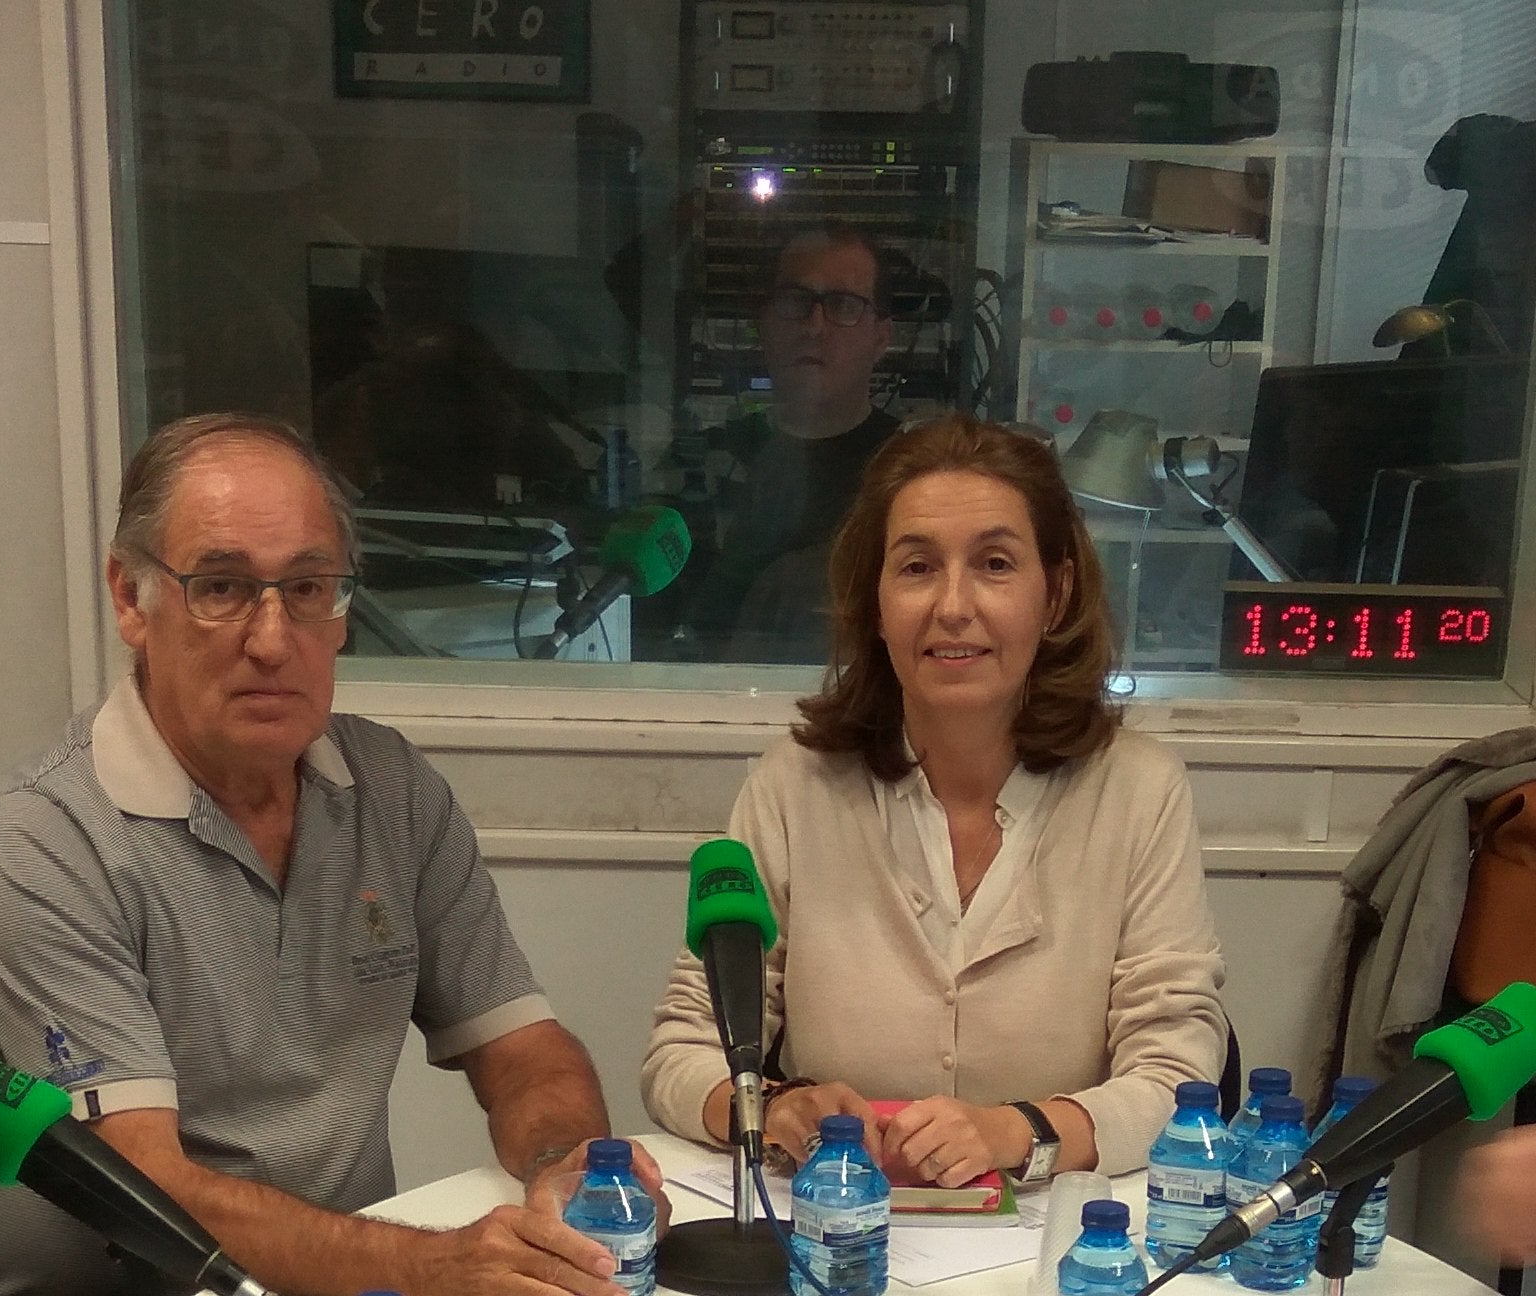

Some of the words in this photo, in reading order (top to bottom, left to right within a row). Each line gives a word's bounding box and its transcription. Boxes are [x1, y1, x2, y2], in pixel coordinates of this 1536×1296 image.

[364, 0, 543, 38] CERO
[367, 59, 547, 77] RADIO
[1244, 605, 1415, 658] 13:11
[1438, 608, 1490, 642] 20
